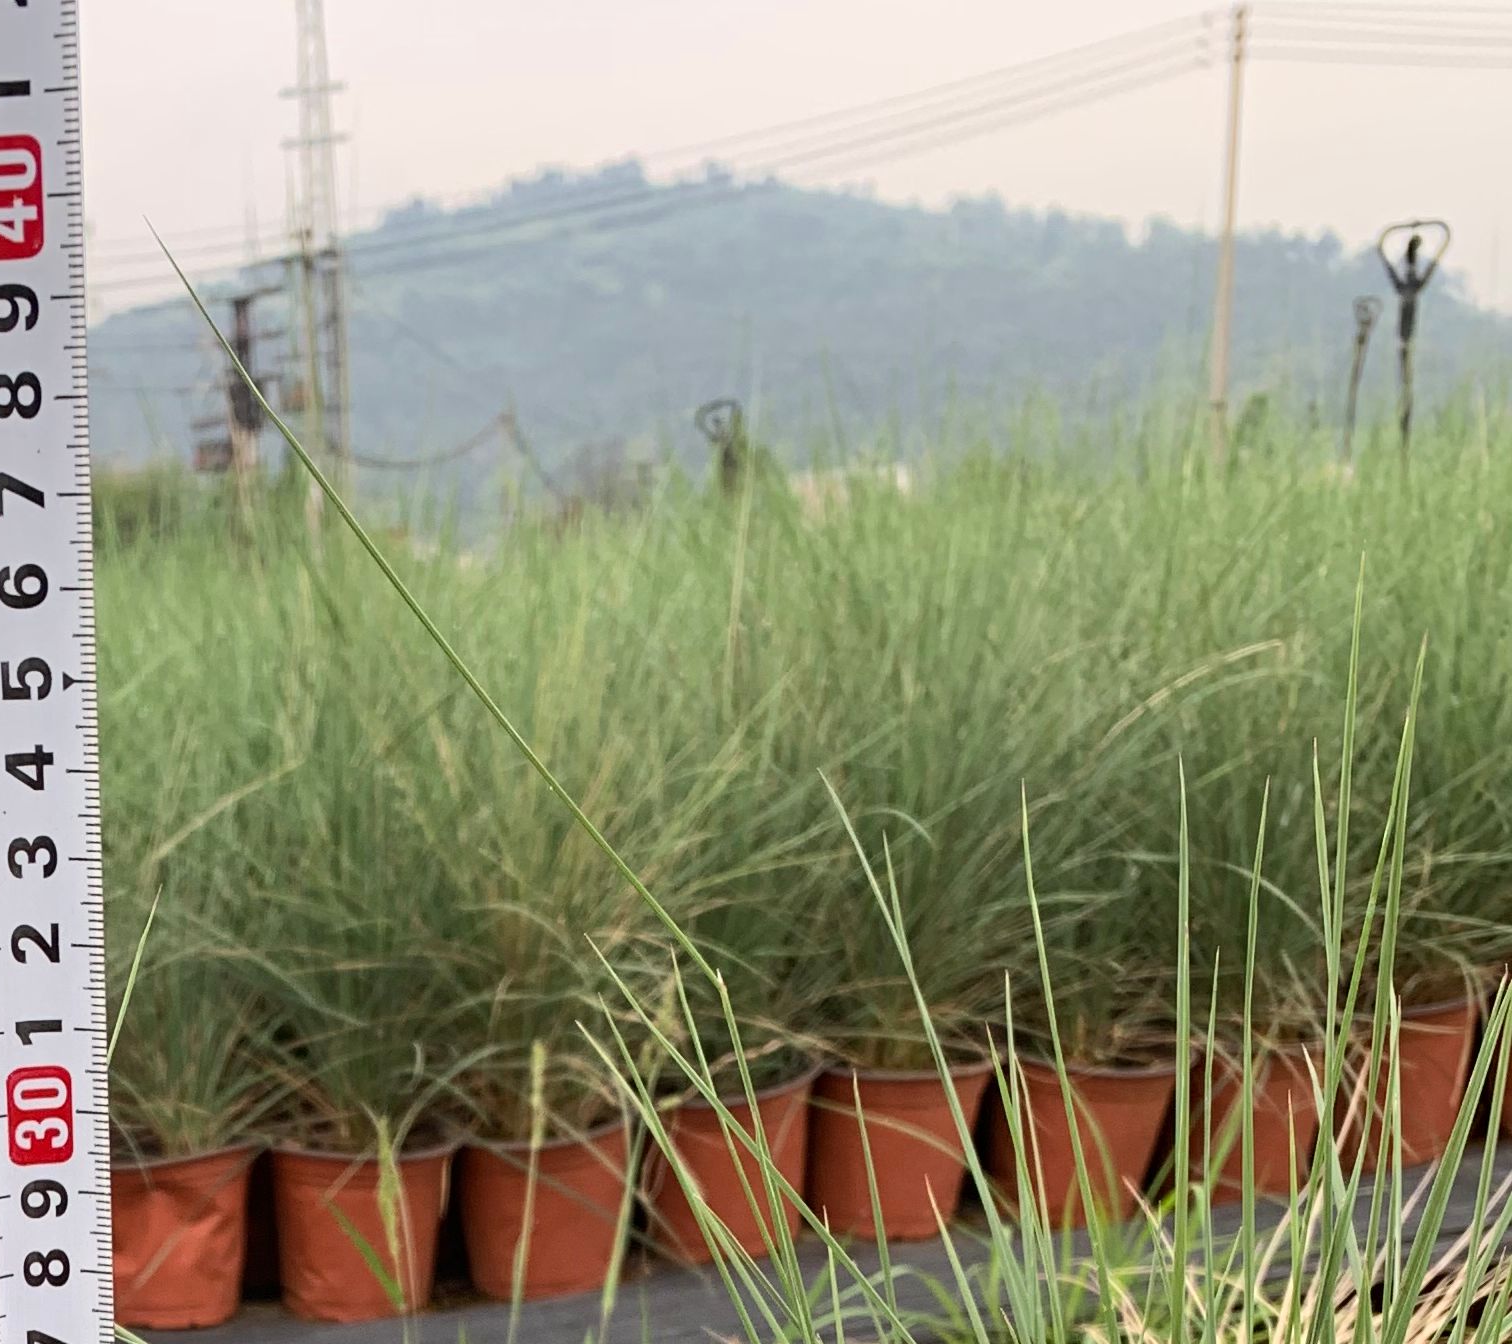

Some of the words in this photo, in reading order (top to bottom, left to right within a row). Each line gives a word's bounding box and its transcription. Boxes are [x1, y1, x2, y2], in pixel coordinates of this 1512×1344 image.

[1, 657, 53, 701] 5
[4, 744, 54, 791] 4
[7, 835, 58, 879] 3
[10, 923, 61, 964] 2
[15, 1019, 63, 1046] 1
[13, 1076, 69, 1151] 30
[20, 1179, 69, 1219] 9
[23, 1248, 71, 1287] 8
